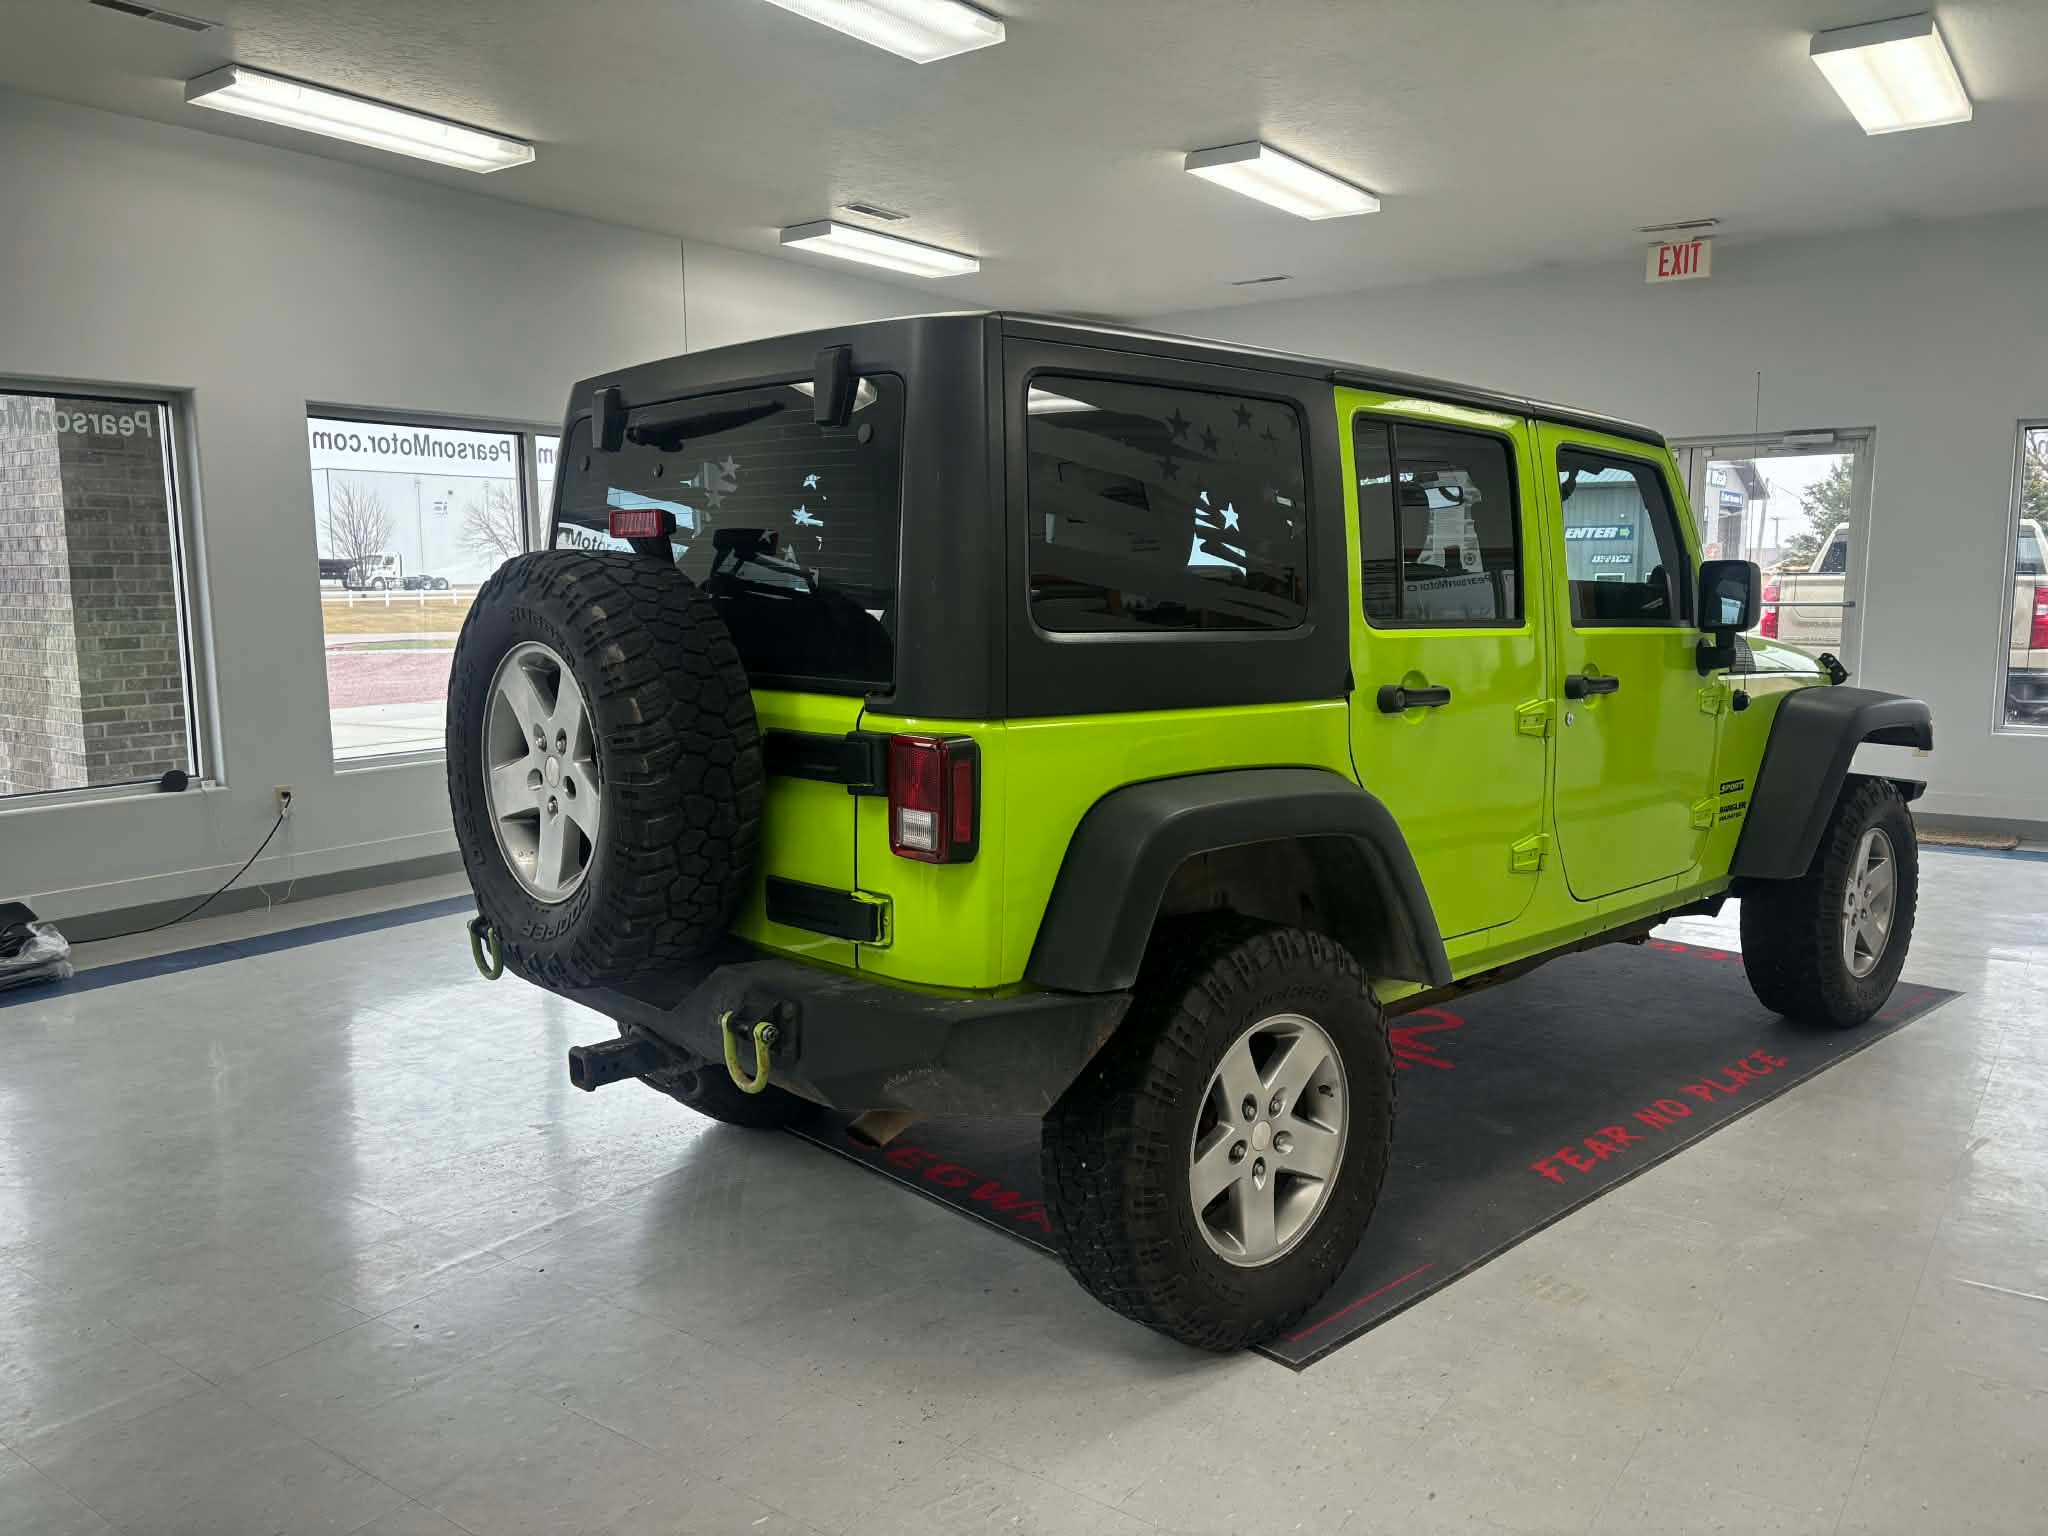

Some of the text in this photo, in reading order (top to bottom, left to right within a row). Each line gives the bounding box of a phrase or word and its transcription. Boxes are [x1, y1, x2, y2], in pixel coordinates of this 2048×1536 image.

[1658, 242, 1703, 277] EXIT
[1528, 1049, 1791, 1185] FEAR NO PLACE
